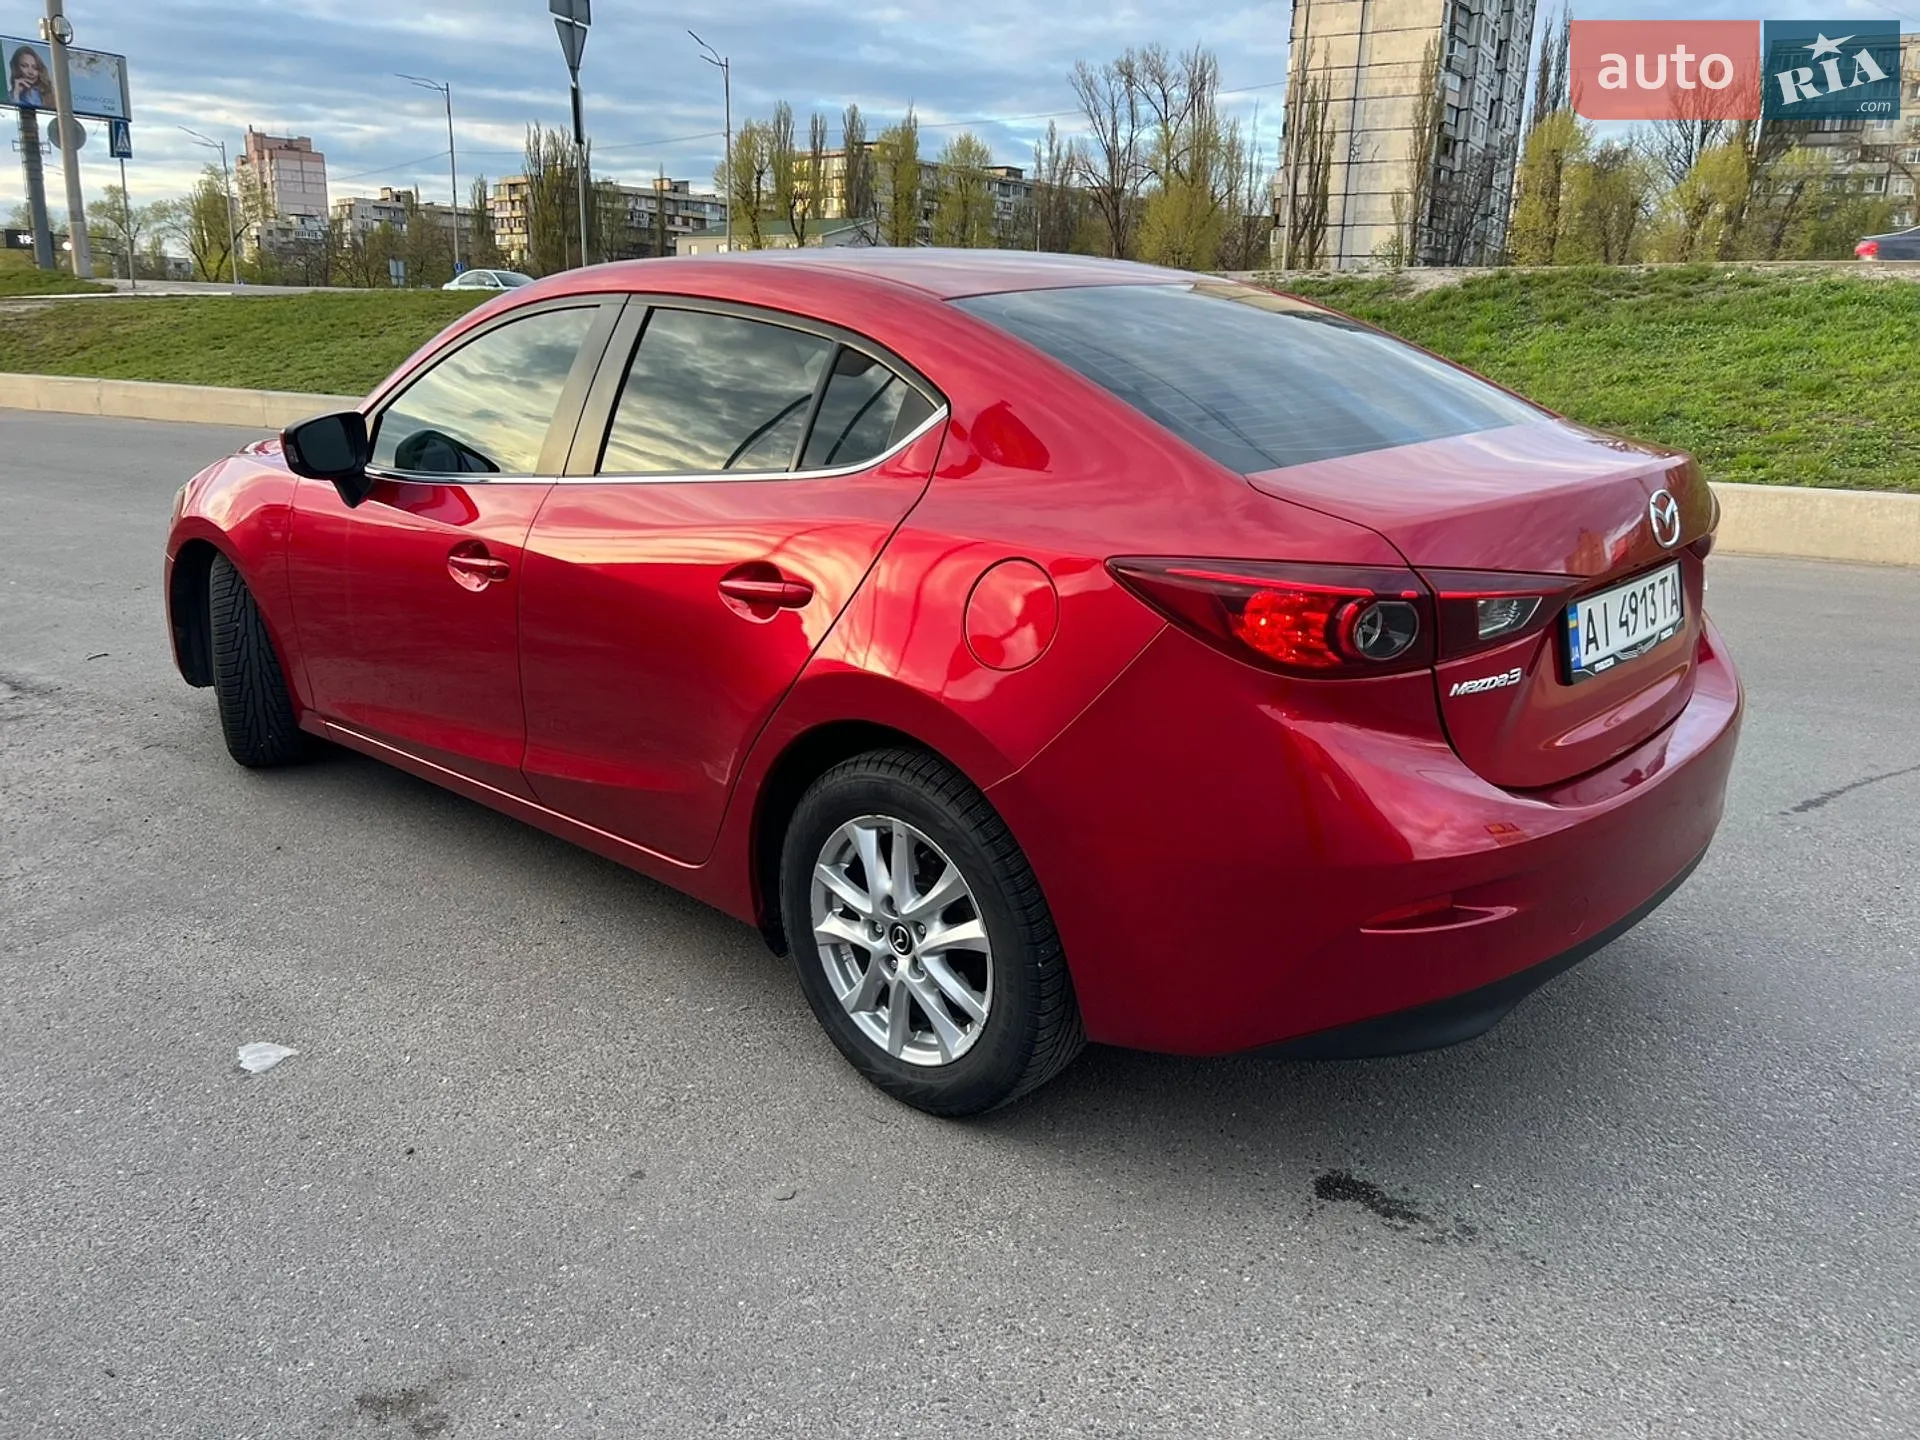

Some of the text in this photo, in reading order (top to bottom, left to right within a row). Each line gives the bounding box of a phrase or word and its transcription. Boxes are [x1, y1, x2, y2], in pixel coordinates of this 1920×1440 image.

[1585, 572, 1680, 656] AI 4913 TA
